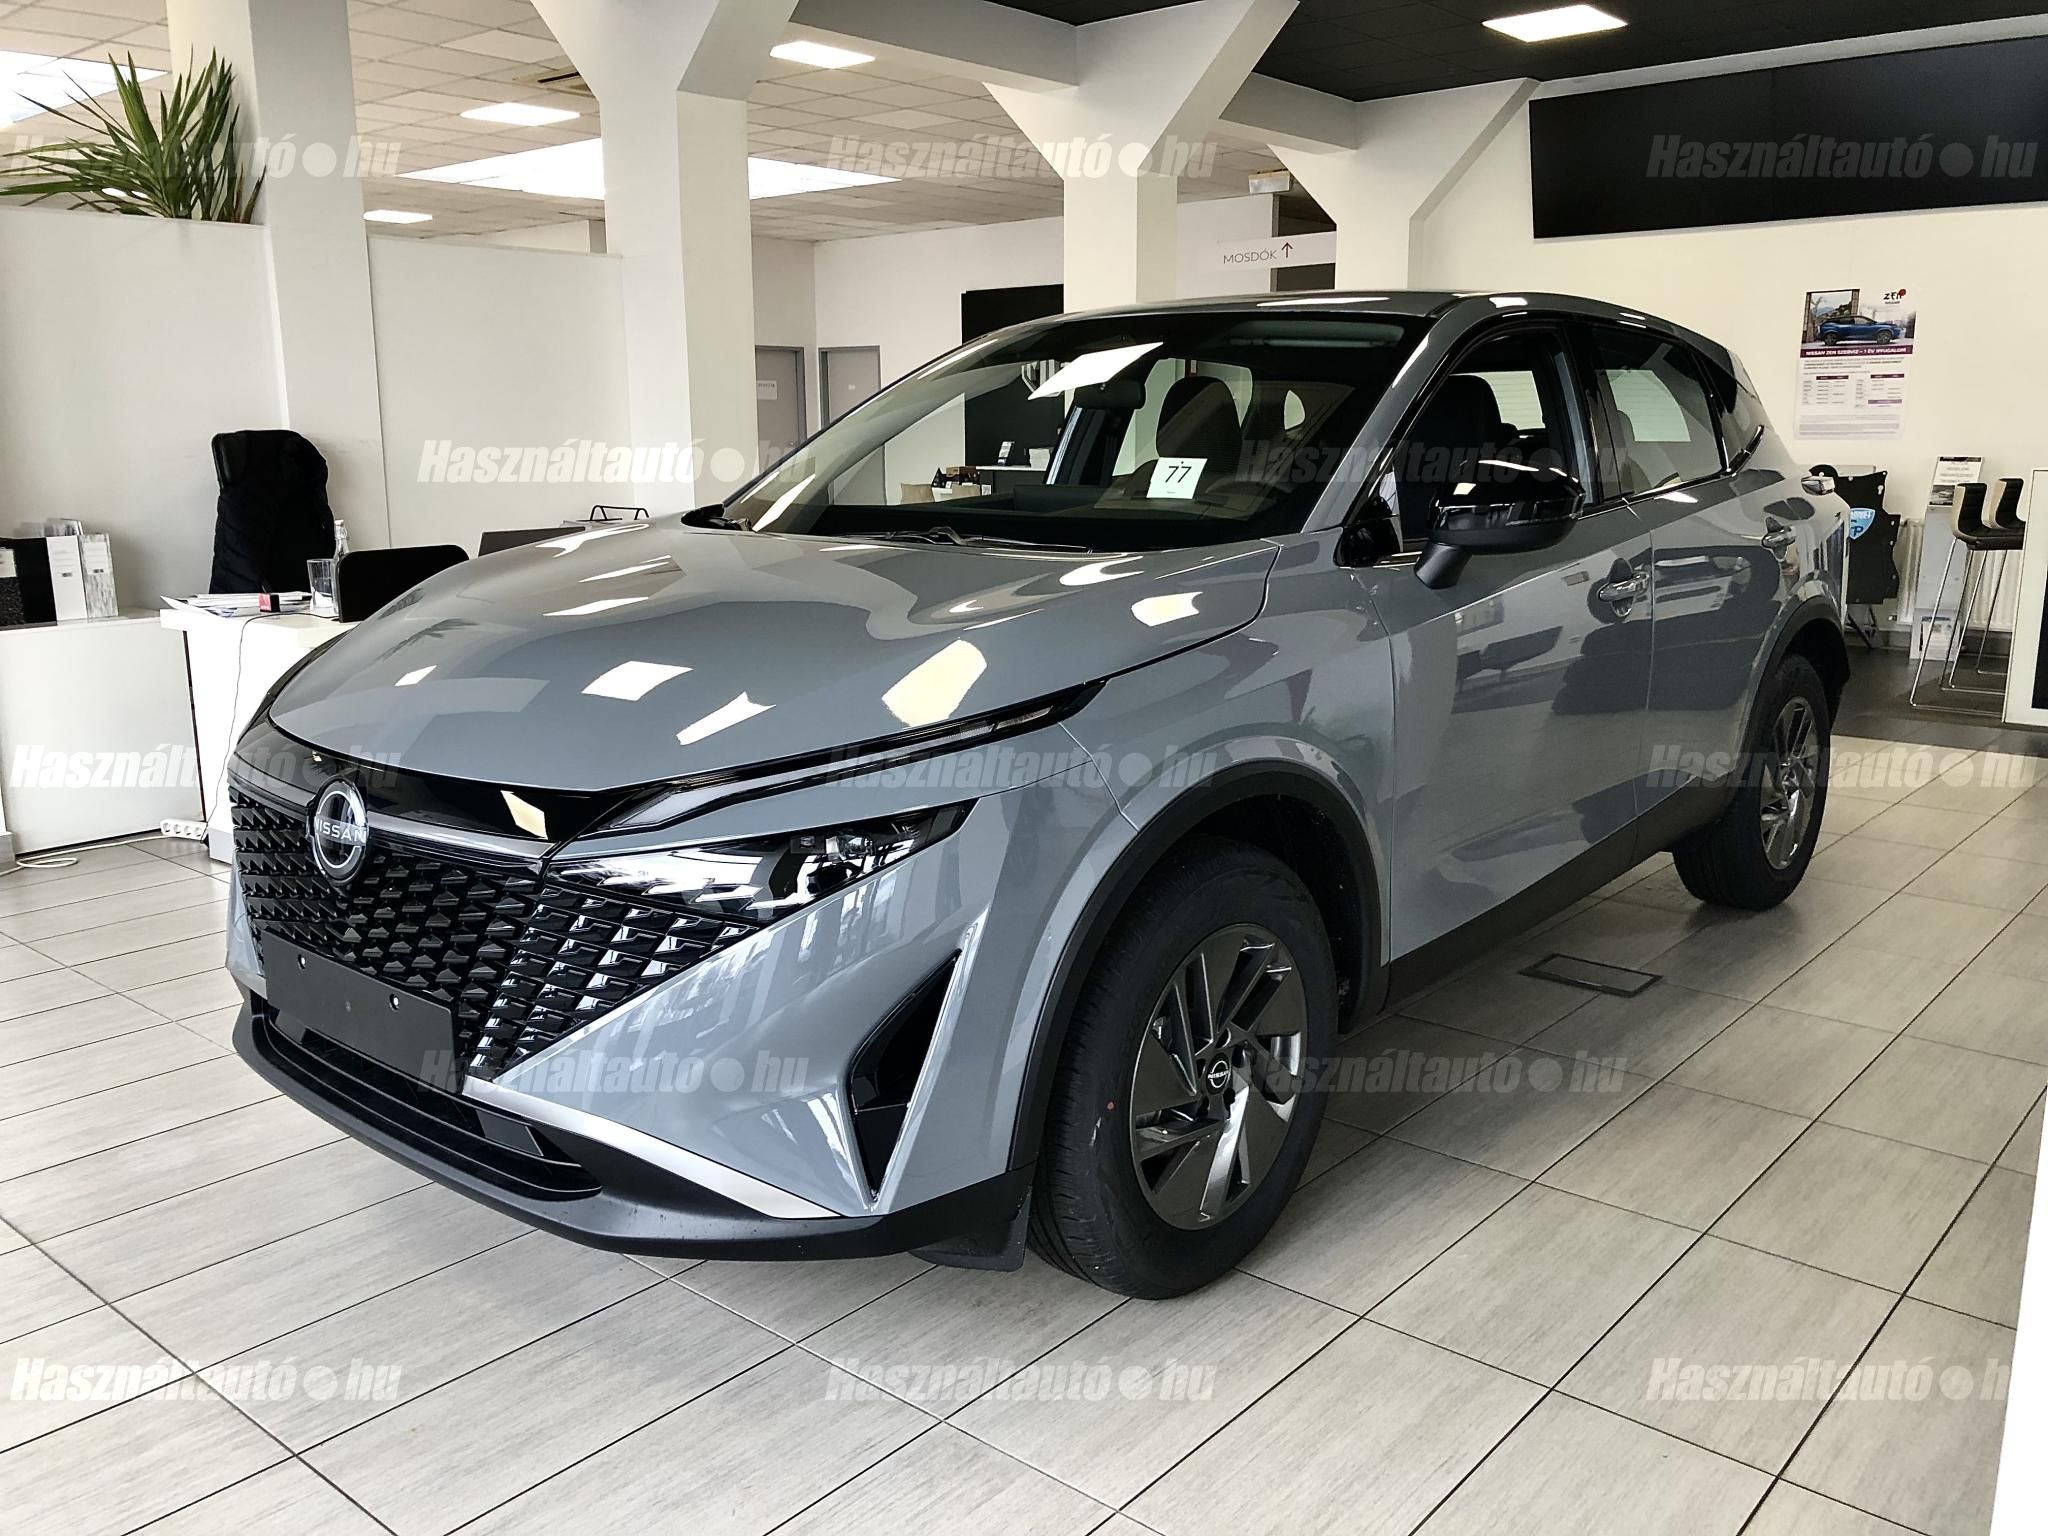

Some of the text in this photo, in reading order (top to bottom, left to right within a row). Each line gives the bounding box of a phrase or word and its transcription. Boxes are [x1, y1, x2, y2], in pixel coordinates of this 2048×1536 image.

[1223, 248, 1277, 264] MOSDÓK
[1165, 465, 1192, 483] 77
[315, 816, 367, 844] NISSAN
